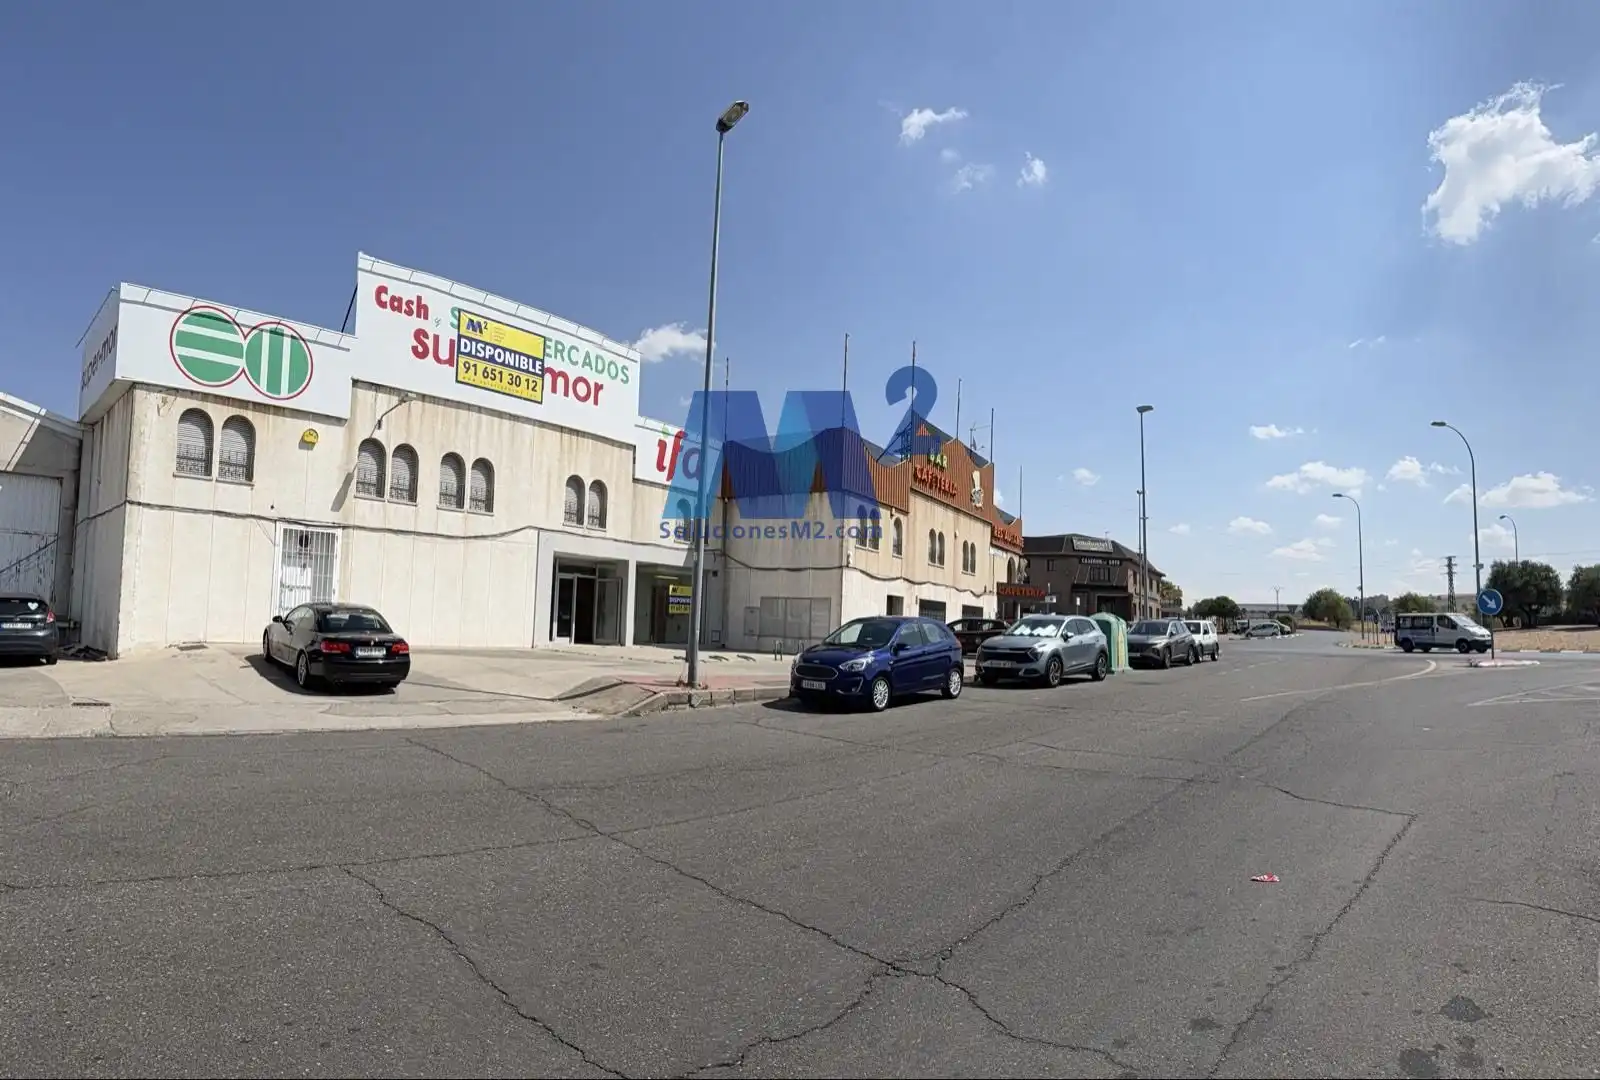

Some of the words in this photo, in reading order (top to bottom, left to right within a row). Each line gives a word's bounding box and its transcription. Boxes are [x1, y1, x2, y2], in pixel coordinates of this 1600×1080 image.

[374, 285, 429, 320] Cash
[460, 338, 542, 375] DISPONIBLE
[462, 360, 478, 377] 91
[482, 366, 503, 384] 651
[507, 373, 521, 388] 30
[525, 378, 538, 392] 12
